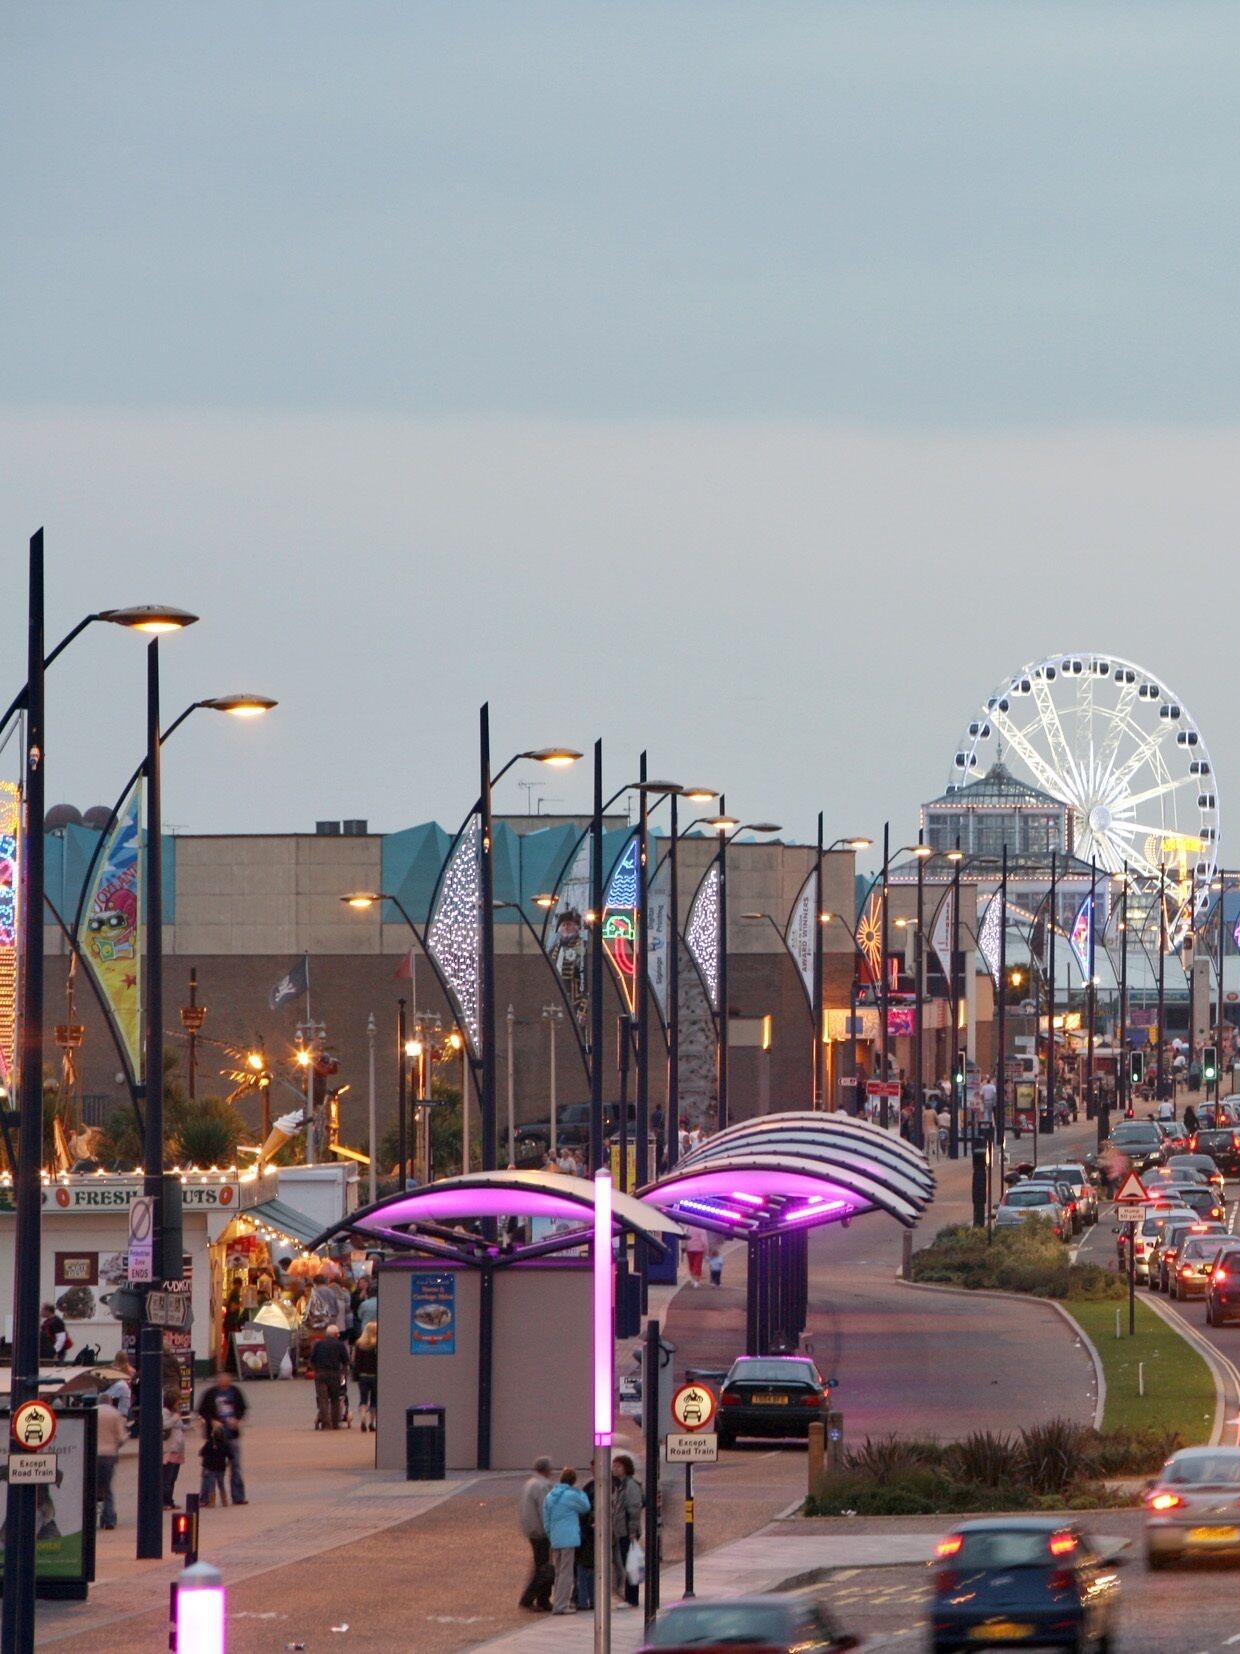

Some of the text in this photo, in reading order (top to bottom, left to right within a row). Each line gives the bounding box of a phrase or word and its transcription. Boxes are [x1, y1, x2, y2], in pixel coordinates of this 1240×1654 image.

[74, 1191, 139, 1205] FRESH
[131, 1269, 149, 1278] ENDS
[679, 1439, 707, 1447] Except
[670, 1447, 714, 1456] Road Train
[19, 1459, 47, 1469] Except
[11, 1468, 54, 1478] Road Train
